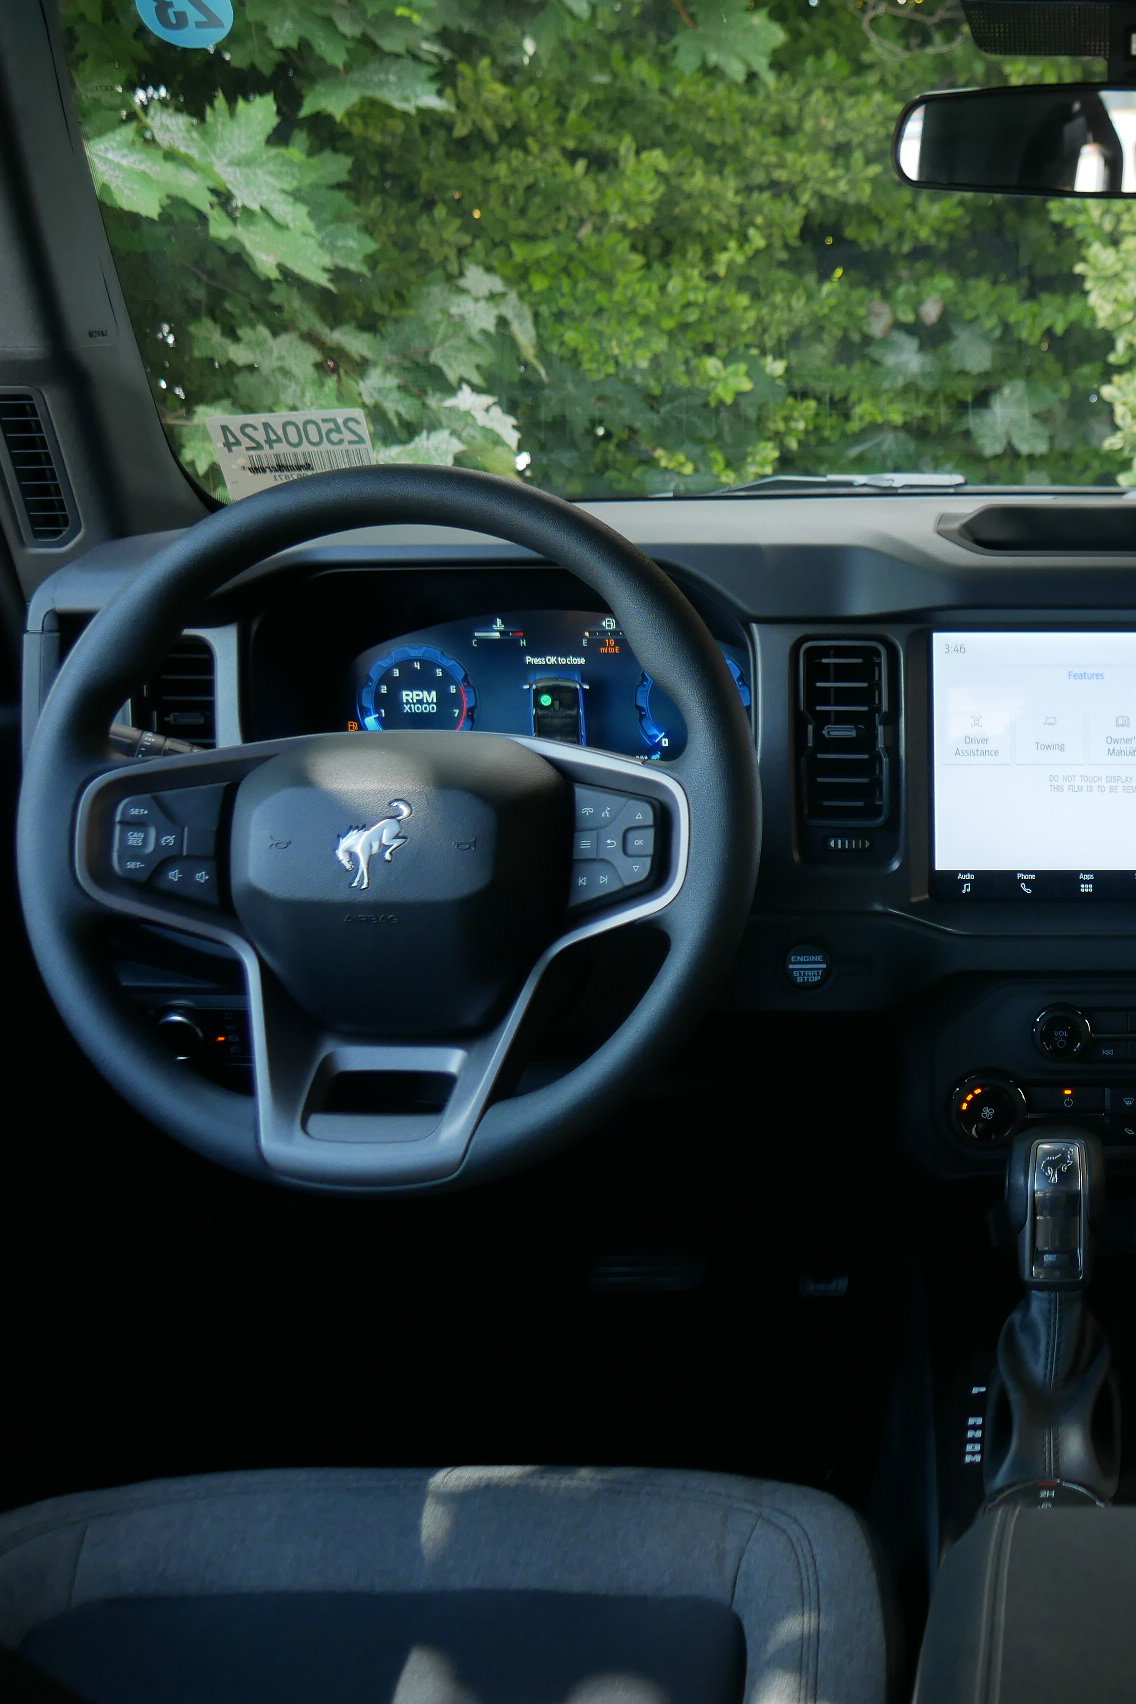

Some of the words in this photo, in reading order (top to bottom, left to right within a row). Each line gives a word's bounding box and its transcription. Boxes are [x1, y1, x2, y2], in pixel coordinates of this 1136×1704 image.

[582, 639, 588, 647] E
[605, 638, 615, 647] 19
[944, 644, 966, 654] 3:46
[526, 656, 546, 665] Press
[546, 656, 558, 665] OK
[558, 656, 567, 665] to
[567, 656, 586, 665] close
[414, 662, 421, 670] 4
[1068, 671, 1105, 680] Features
[381, 685, 388, 694] 2
[402, 690, 437, 703] RPM
[403, 704, 437, 713] X1000
[381, 709, 386, 718] 1
[454, 709, 460, 718] 7
[964, 736, 989, 745] Driver
[1034, 741, 1065, 753] Towing
[954, 748, 999, 757] Assistance
[1049, 775, 1059, 784] DO
[1062, 775, 1076, 784] NOT
[1079, 775, 1103, 784] TOUCH
[1105, 775, 1133, 784] DISPLAY
[1050, 785, 1066, 794] THIS
[1068, 785, 1083, 794] FILM
[1086, 785, 1094, 794] IS
[1097, 785, 1106, 794] TO
[1109, 785, 1119, 794] BE
[1079, 873, 1094, 881] Apps
